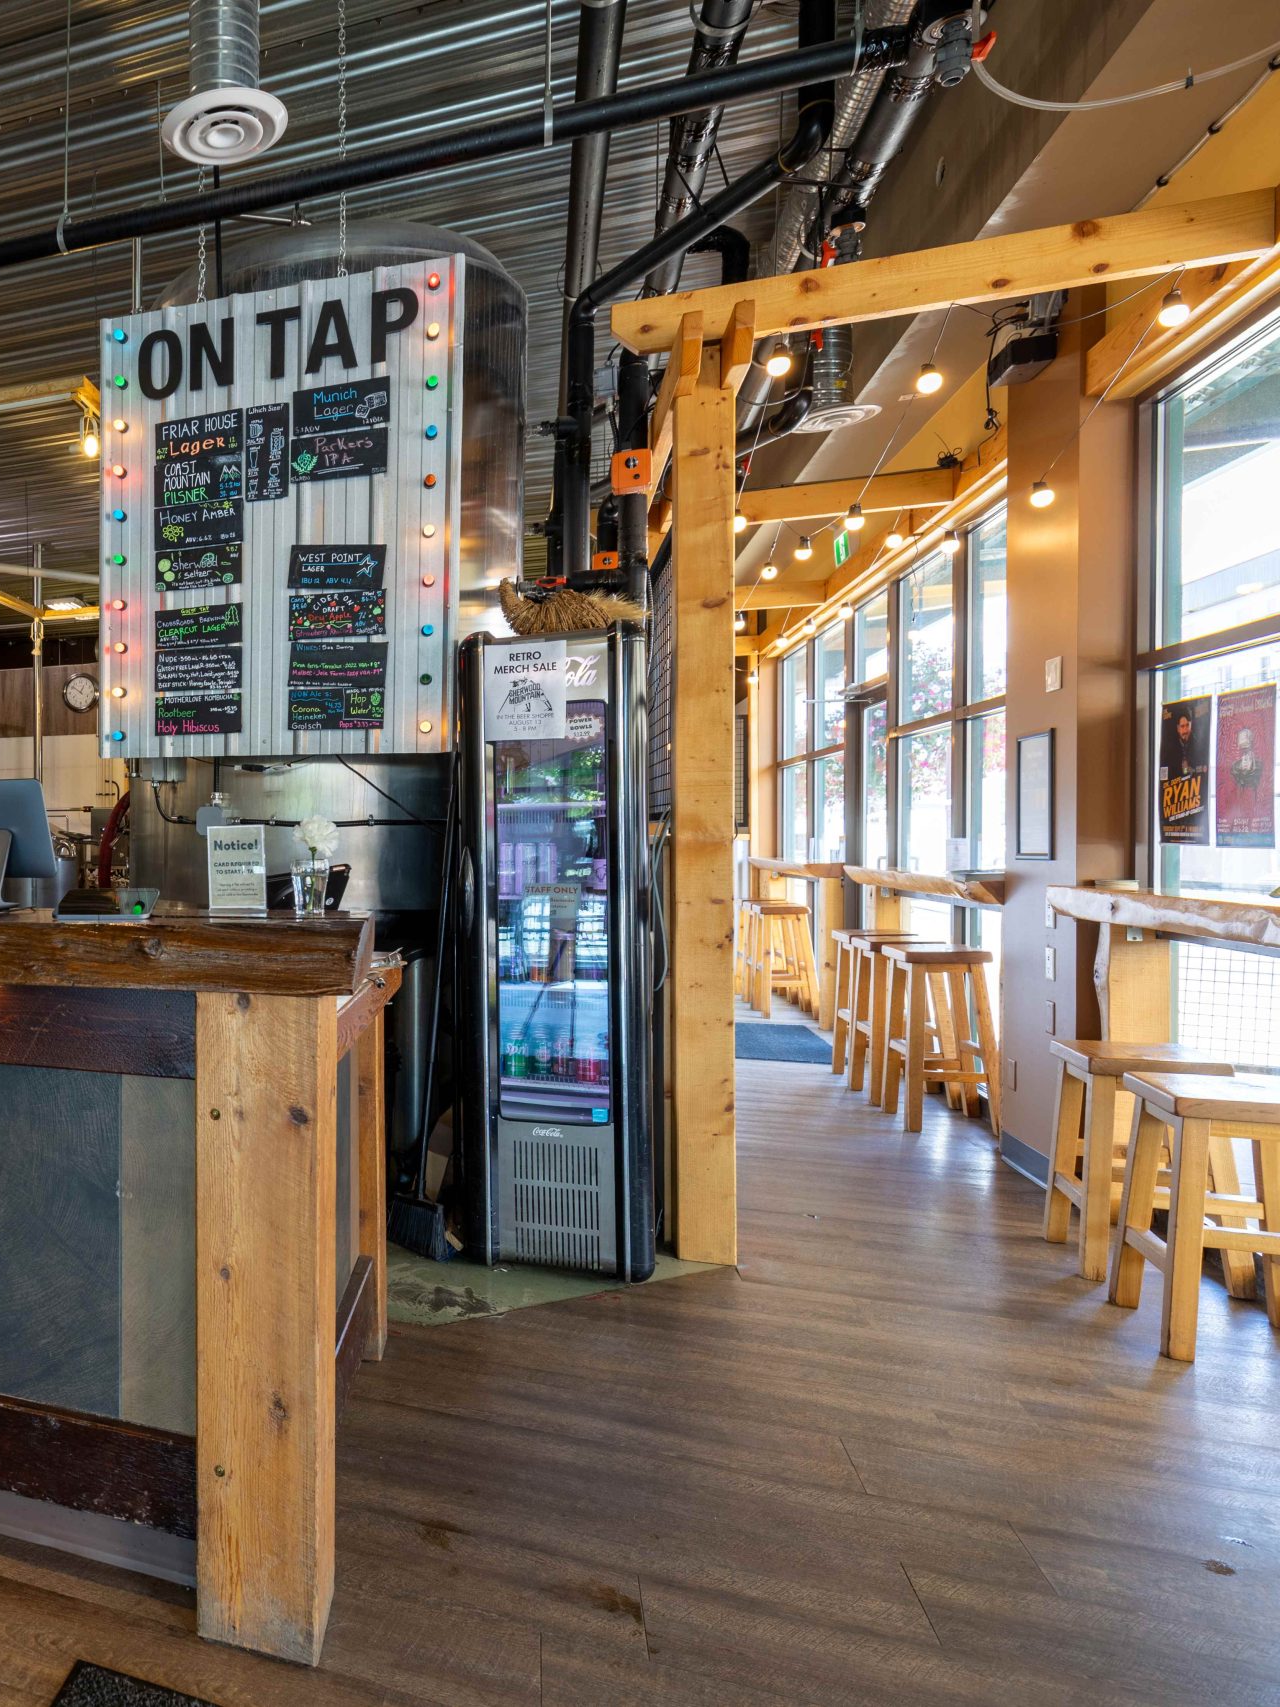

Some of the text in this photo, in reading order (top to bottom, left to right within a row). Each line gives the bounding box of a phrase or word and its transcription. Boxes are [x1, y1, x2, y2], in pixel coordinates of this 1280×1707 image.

[138, 287, 419, 401] ON TAP
[313, 387, 357, 405] Munich
[248, 406, 267, 415] Which
[314, 404, 354, 421] Lager
[162, 412, 238, 441] FRIAR HOUSE
[324, 453, 354, 467] IPA
[165, 460, 197, 477] COAST
[164, 471, 211, 492] MOUNTAIN
[164, 487, 209, 506] PILSNER
[298, 553, 363, 563] WEST POINT
[313, 593, 354, 611] CIDER ON
[322, 605, 345, 613] DRAFT
[158, 623, 227, 638] CLEARCUT LAGER
[158, 653, 178, 663] NUDE
[509, 651, 542, 662] RETRO
[493, 662, 557, 675] MERCH SALE
[508, 683, 541, 698] SHERWOOD
[164, 693, 233, 704] MOTHERLOVE KOMBUCHA
[350, 693, 367, 706] Hop
[509, 691, 541, 705] MOUNTAIN
[158, 707, 197, 718] Rootbeer
[291, 704, 321, 713] Corona
[292, 713, 327, 721] Heineken
[157, 719, 220, 736] Holy Hibiscus
[291, 721, 322, 730] Grolsch
[1163, 775, 1201, 808] RYAN
[1163, 795, 1201, 818] WILLIAMS
[213, 839, 258, 851] Notice!
[525, 886, 578, 894] STAFF ONLY
